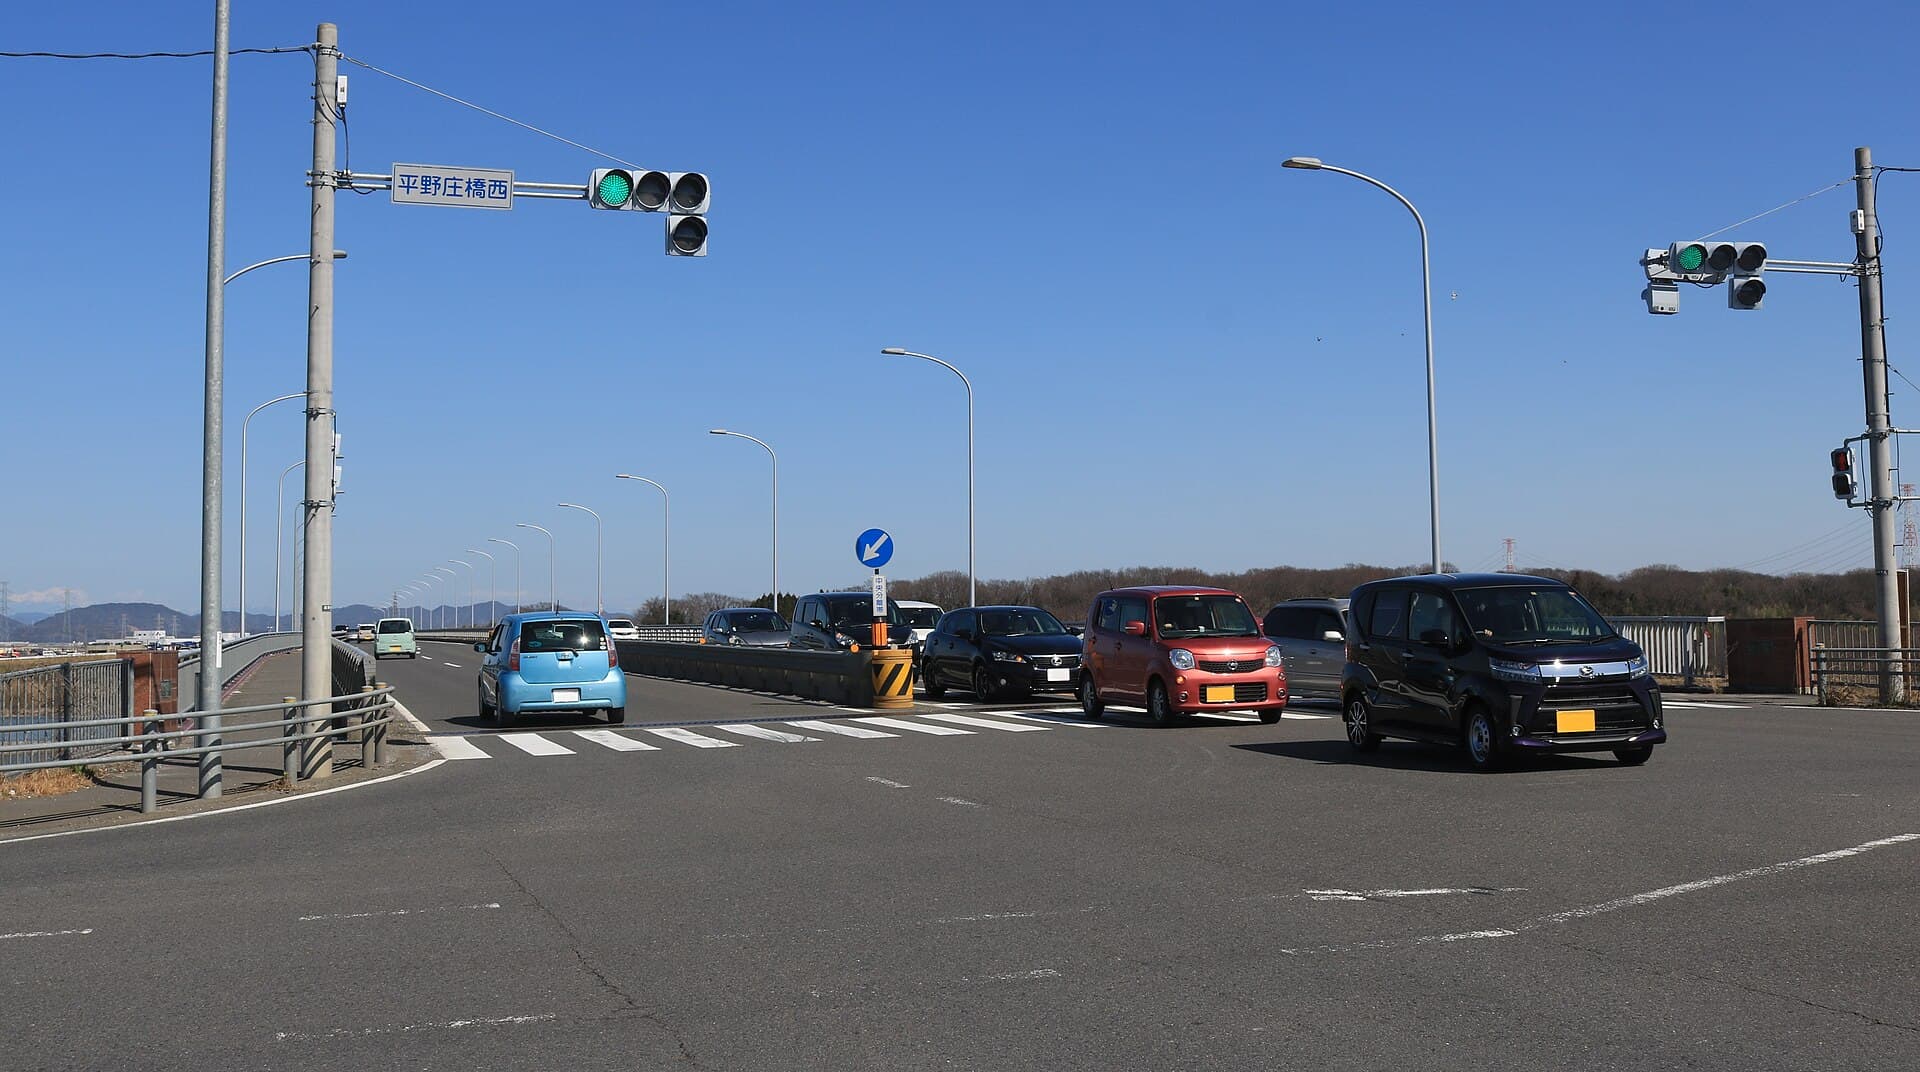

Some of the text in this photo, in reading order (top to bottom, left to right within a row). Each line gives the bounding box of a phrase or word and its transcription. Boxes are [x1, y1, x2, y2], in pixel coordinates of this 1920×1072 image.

[398, 174, 508, 200] 平野庄橋西
